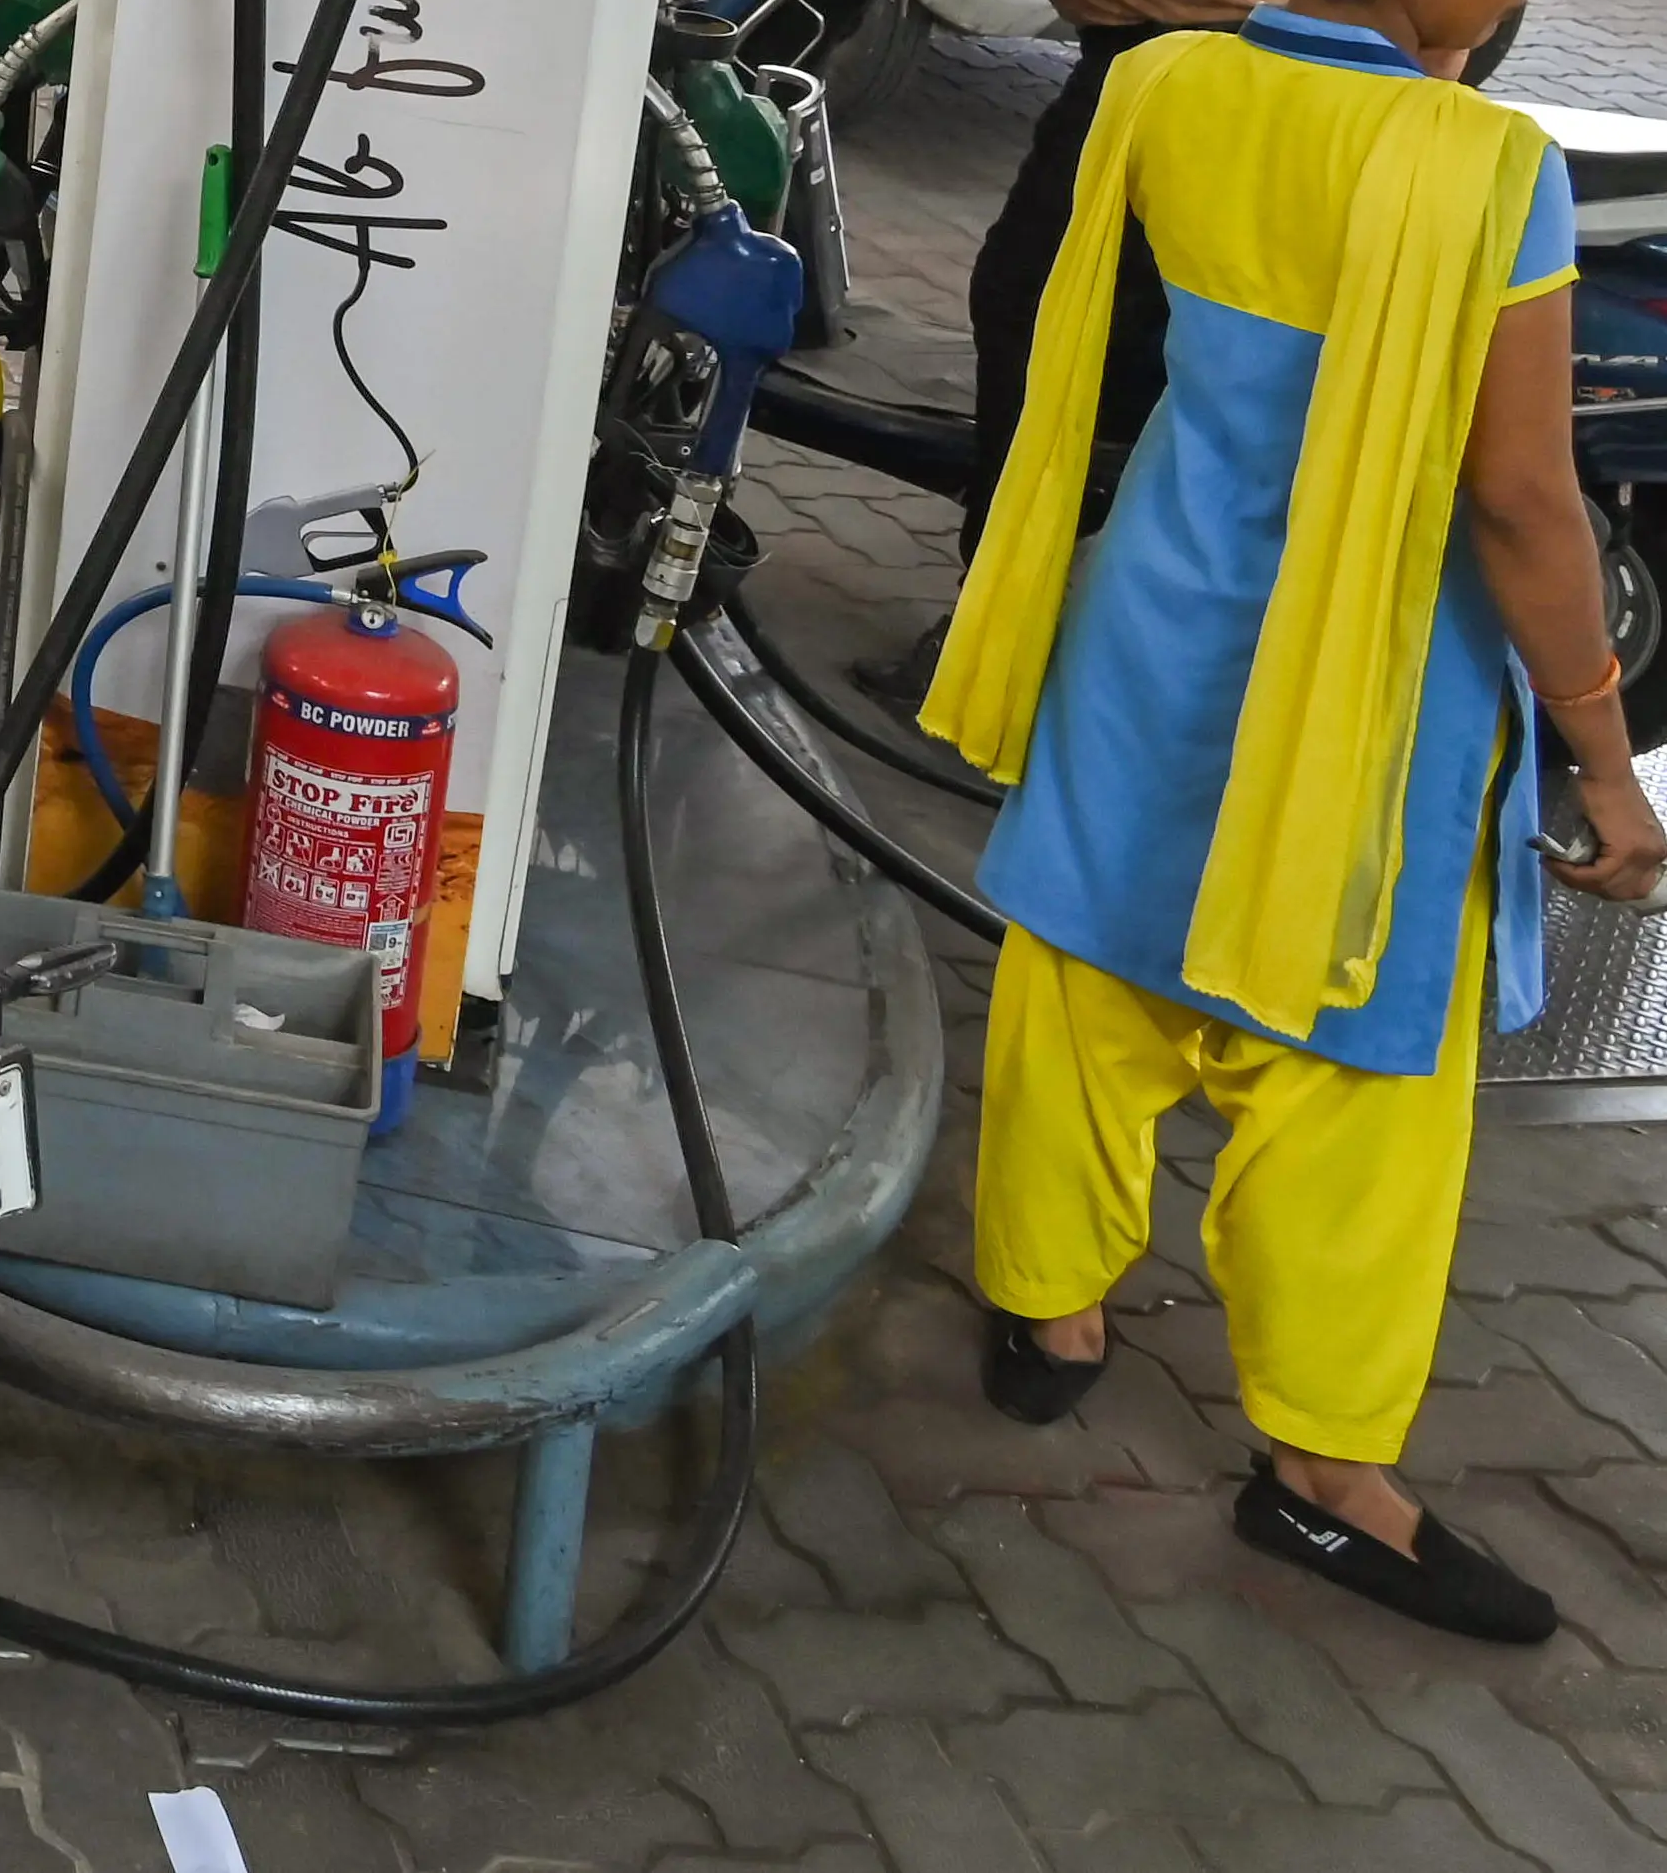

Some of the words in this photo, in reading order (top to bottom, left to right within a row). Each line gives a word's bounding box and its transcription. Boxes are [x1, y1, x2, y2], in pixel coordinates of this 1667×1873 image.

[301, 702, 324, 725] BC
[329, 711, 411, 738] POWDER
[271, 768, 341, 808] STOP
[286, 799, 333, 821] CHEMICAL
[336, 814, 380, 828] POWDER
